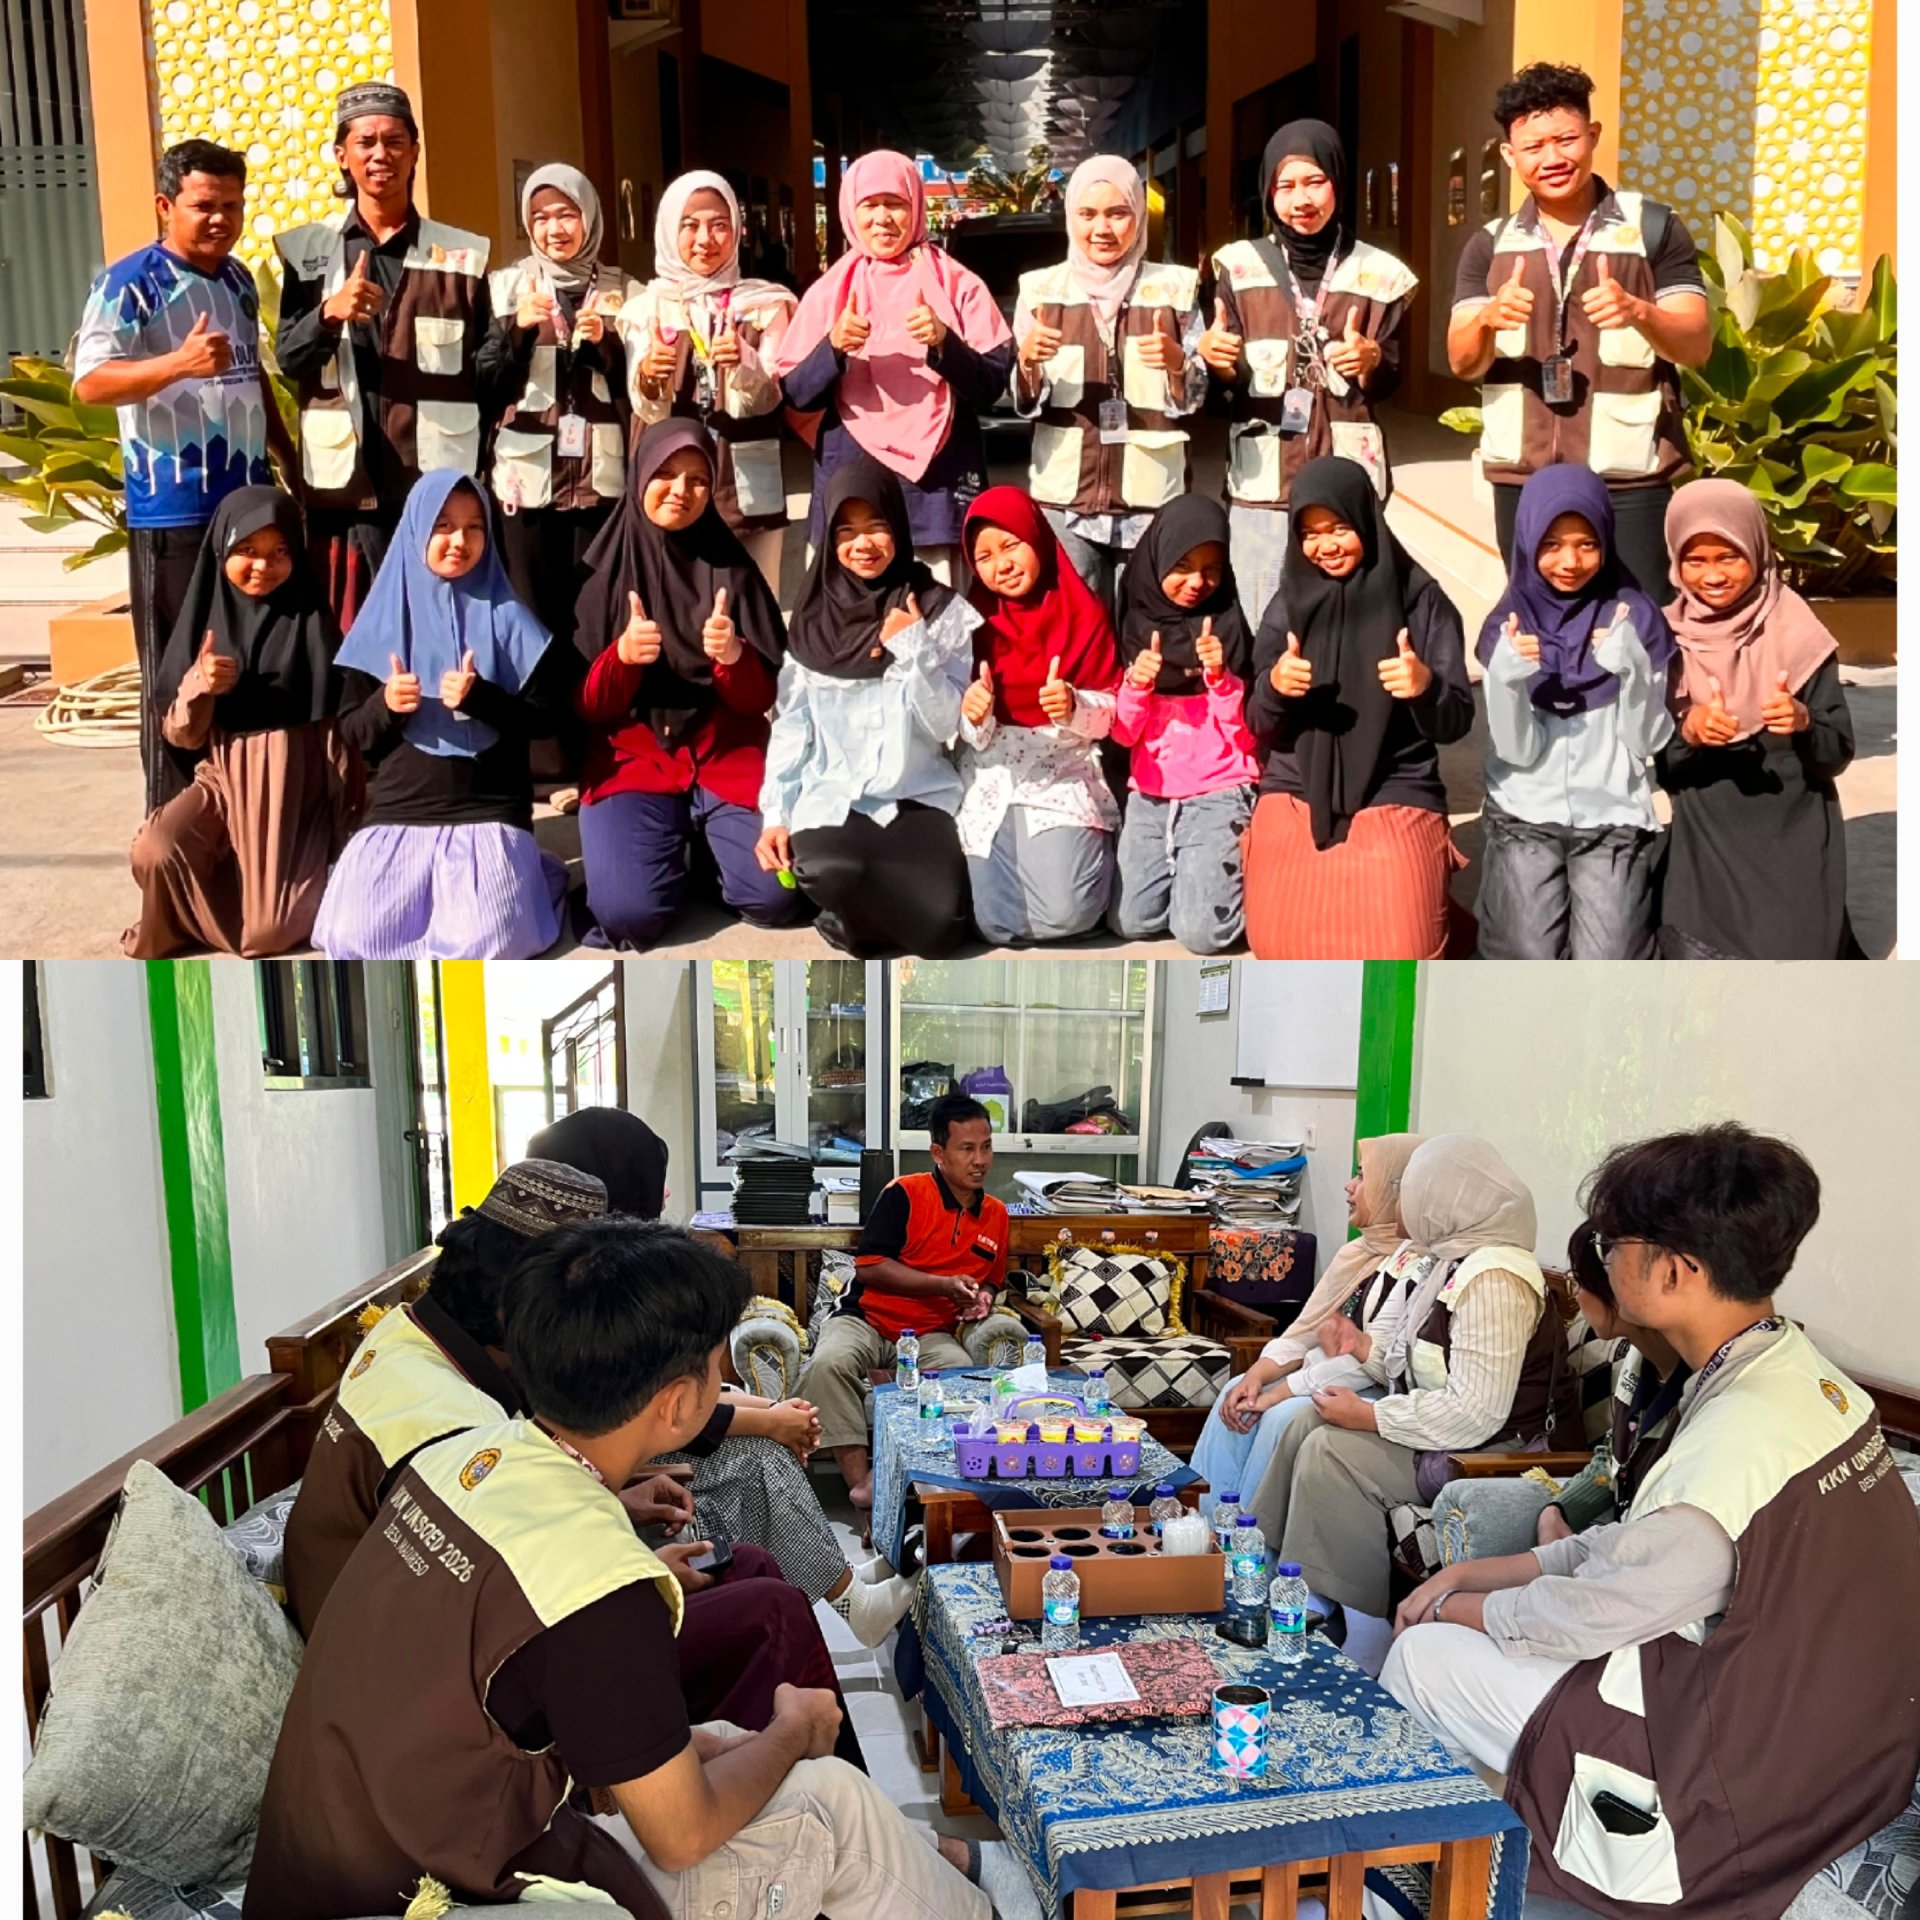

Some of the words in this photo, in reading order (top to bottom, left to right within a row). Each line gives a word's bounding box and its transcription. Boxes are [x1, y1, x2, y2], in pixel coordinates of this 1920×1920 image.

[1817, 1461, 1852, 1495] KKN
[402, 1502, 446, 1552] UNSOED
[437, 1543, 475, 1583] 2026
